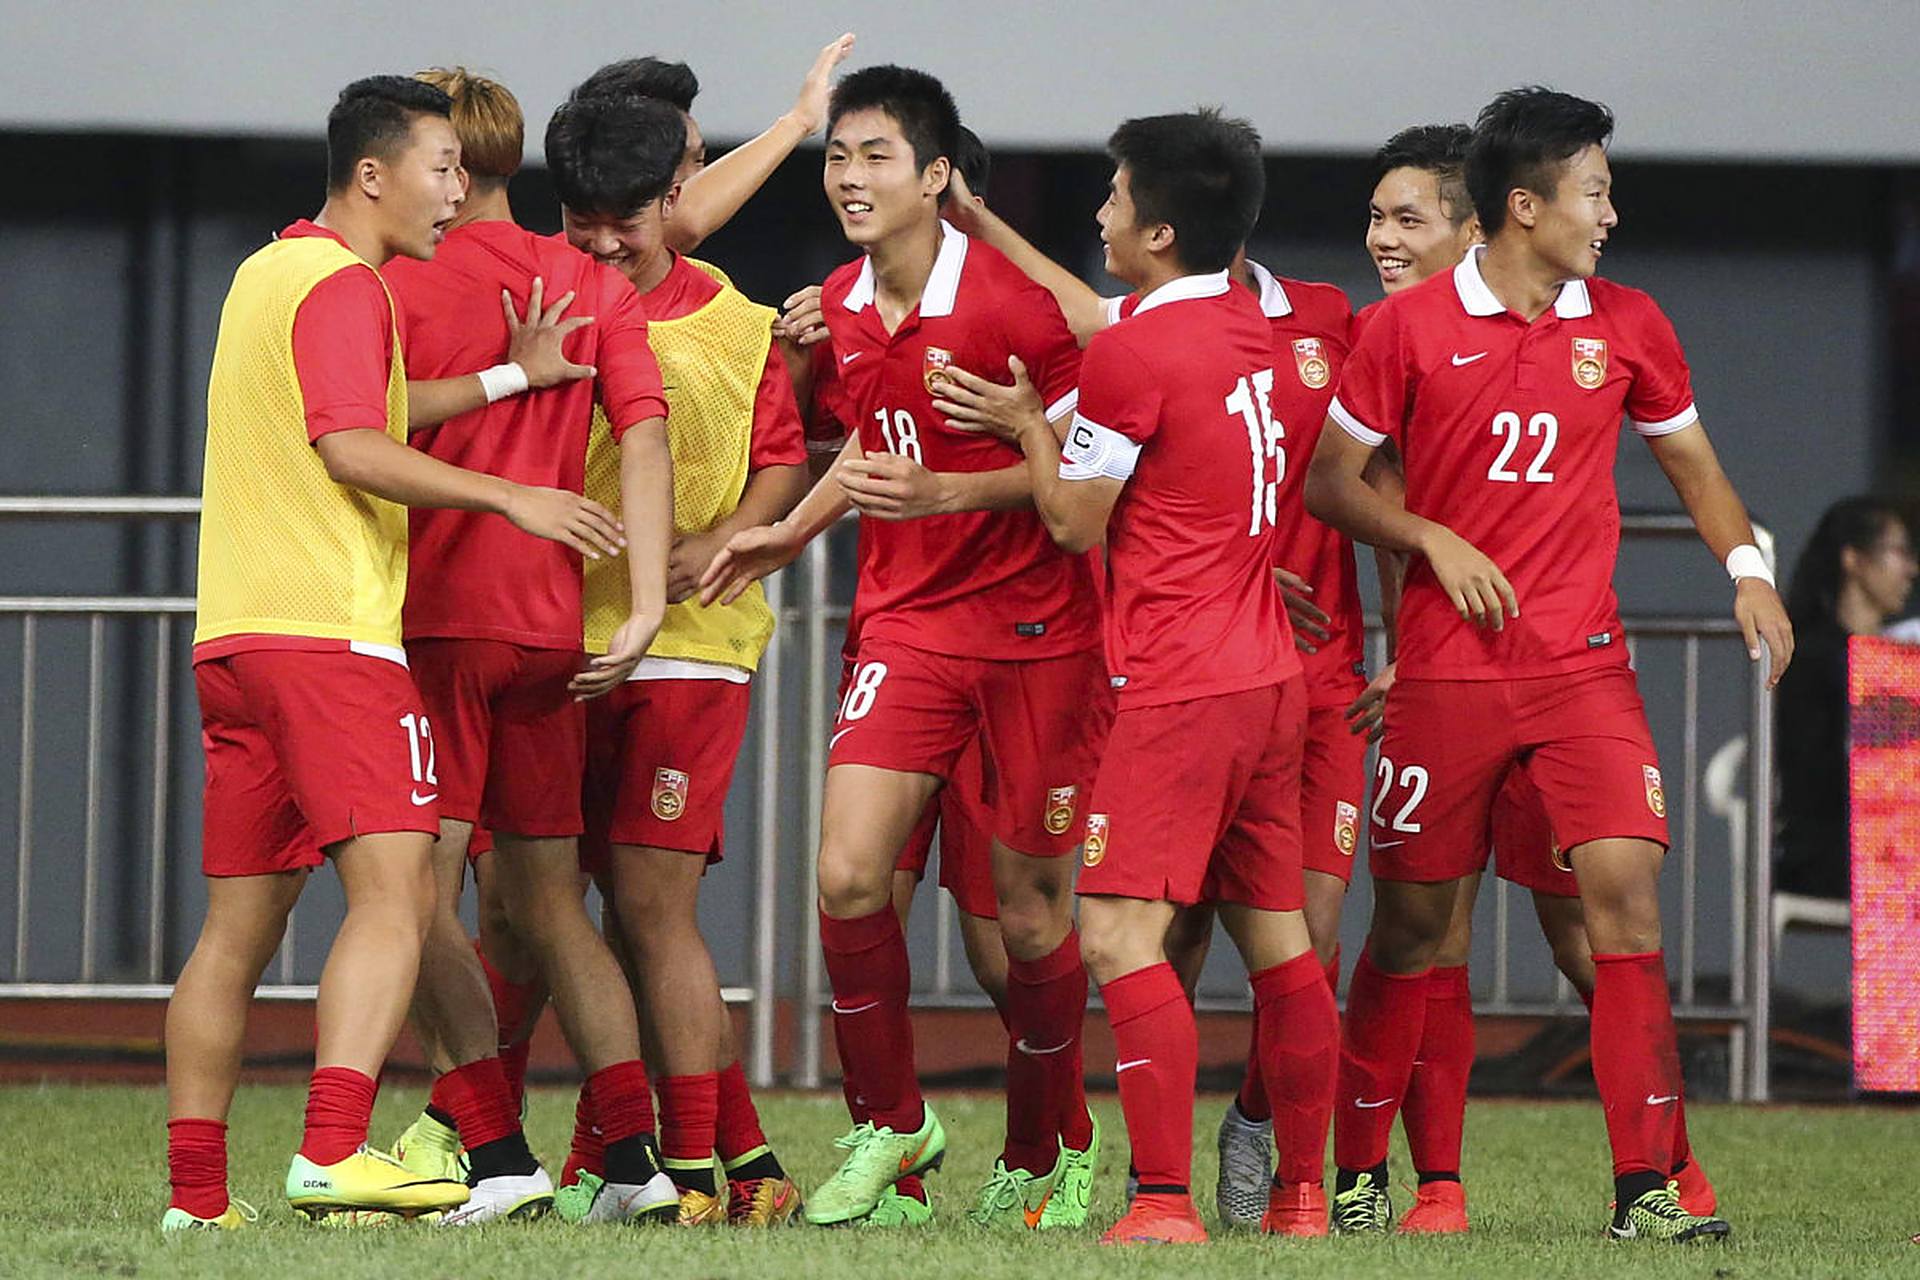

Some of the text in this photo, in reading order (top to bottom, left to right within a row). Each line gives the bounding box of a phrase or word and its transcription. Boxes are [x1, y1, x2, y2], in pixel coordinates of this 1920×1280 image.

[874, 407, 923, 467] 18
[1074, 426, 1093, 449] C
[1225, 368, 1286, 537] 15
[1487, 411, 1559, 483] 22
[399, 713, 438, 786] 12
[1371, 756, 1429, 833] 22
